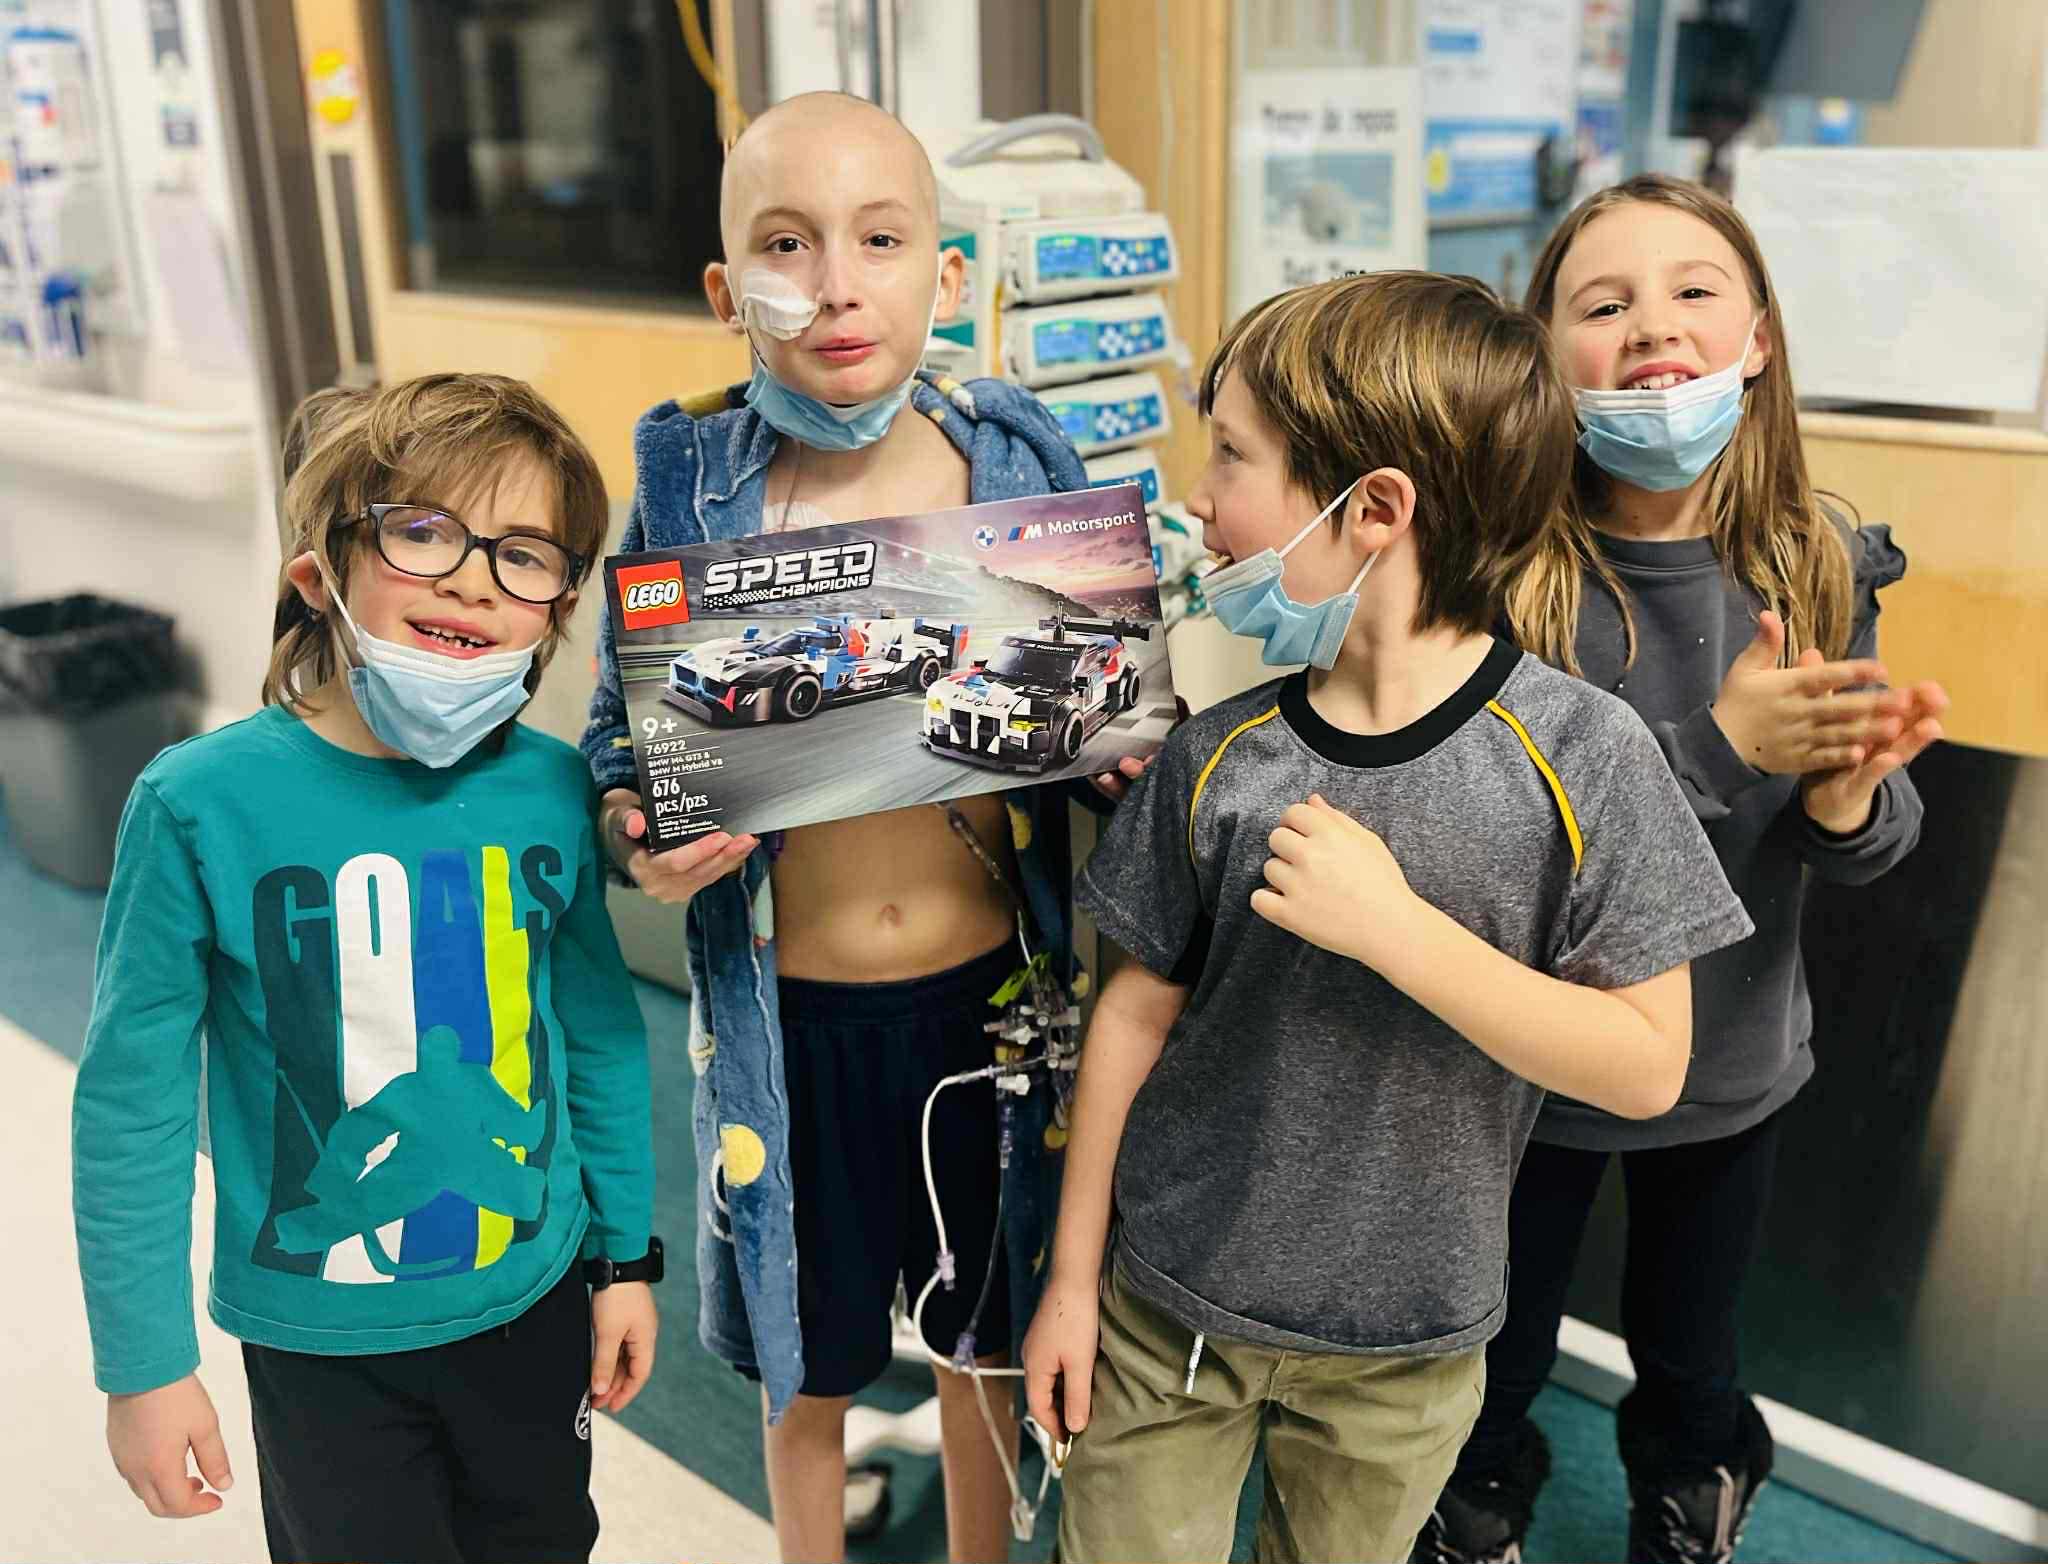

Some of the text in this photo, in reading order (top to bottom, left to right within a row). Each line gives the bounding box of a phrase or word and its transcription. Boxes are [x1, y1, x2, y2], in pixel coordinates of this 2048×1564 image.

[1047, 511, 1136, 535] Motorsport
[704, 541, 874, 596] SPEED
[626, 580, 680, 609] LEGO
[642, 717, 677, 740] 9+
[645, 740, 687, 755] 76922
[648, 758, 669, 768] BMW
[649, 767, 670, 776] BMW
[672, 765, 681, 773] M
[682, 760, 710, 771] Hybrid
[652, 778, 680, 797] 676
[655, 792, 708, 817] pcs/pzs
[250, 844, 566, 1284] GOALS
